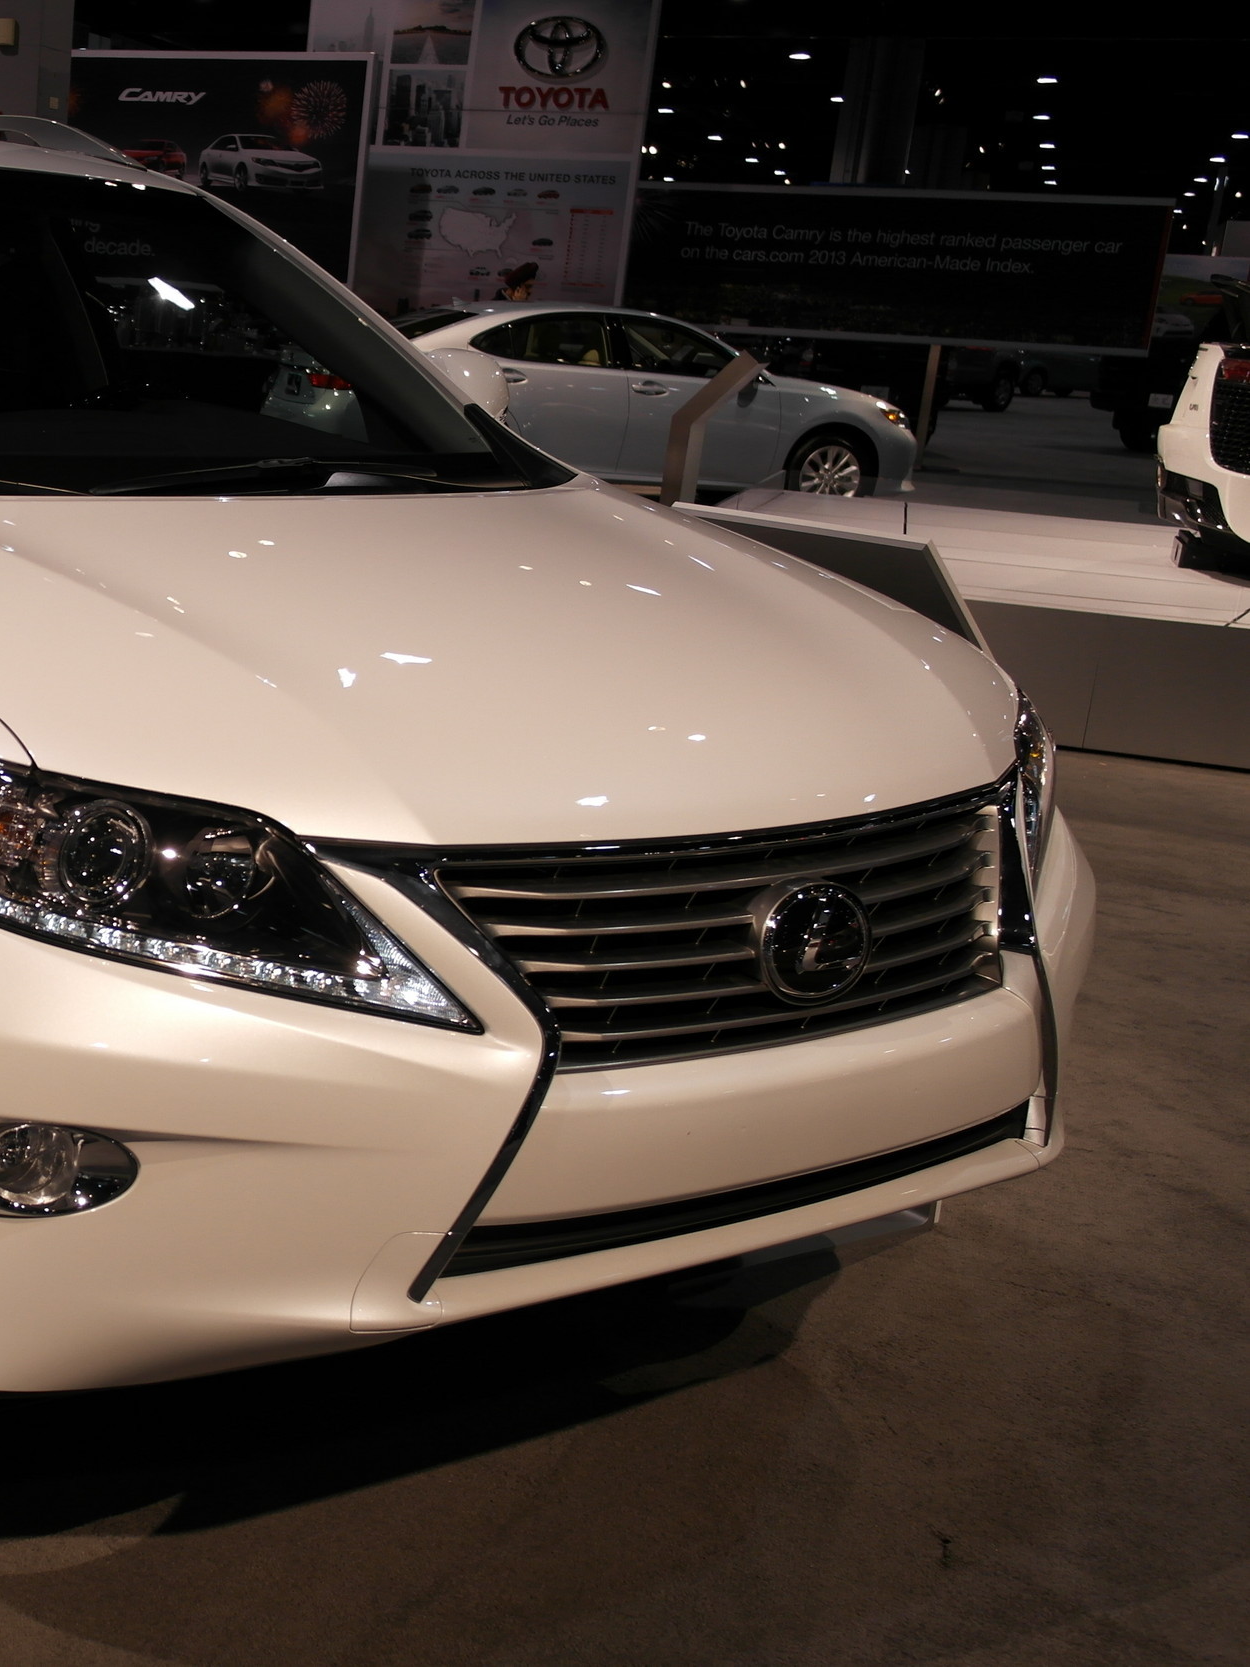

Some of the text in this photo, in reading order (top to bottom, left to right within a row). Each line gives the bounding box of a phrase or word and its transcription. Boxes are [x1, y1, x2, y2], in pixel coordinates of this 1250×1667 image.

[118, 87, 206, 105] CAMRY
[499, 86, 609, 110] TOYOTA
[506, 114, 599, 128] Let's Go Places
[410, 167, 616, 185] TOYOTA ACROSS THE UNITED STATES
[83, 236, 156, 256] decade.
[686, 221, 1123, 256] The Toyota Camry is the highest ranked passenger car
[681, 244, 1035, 274] on the cars.com 2013 American-Made Index.
